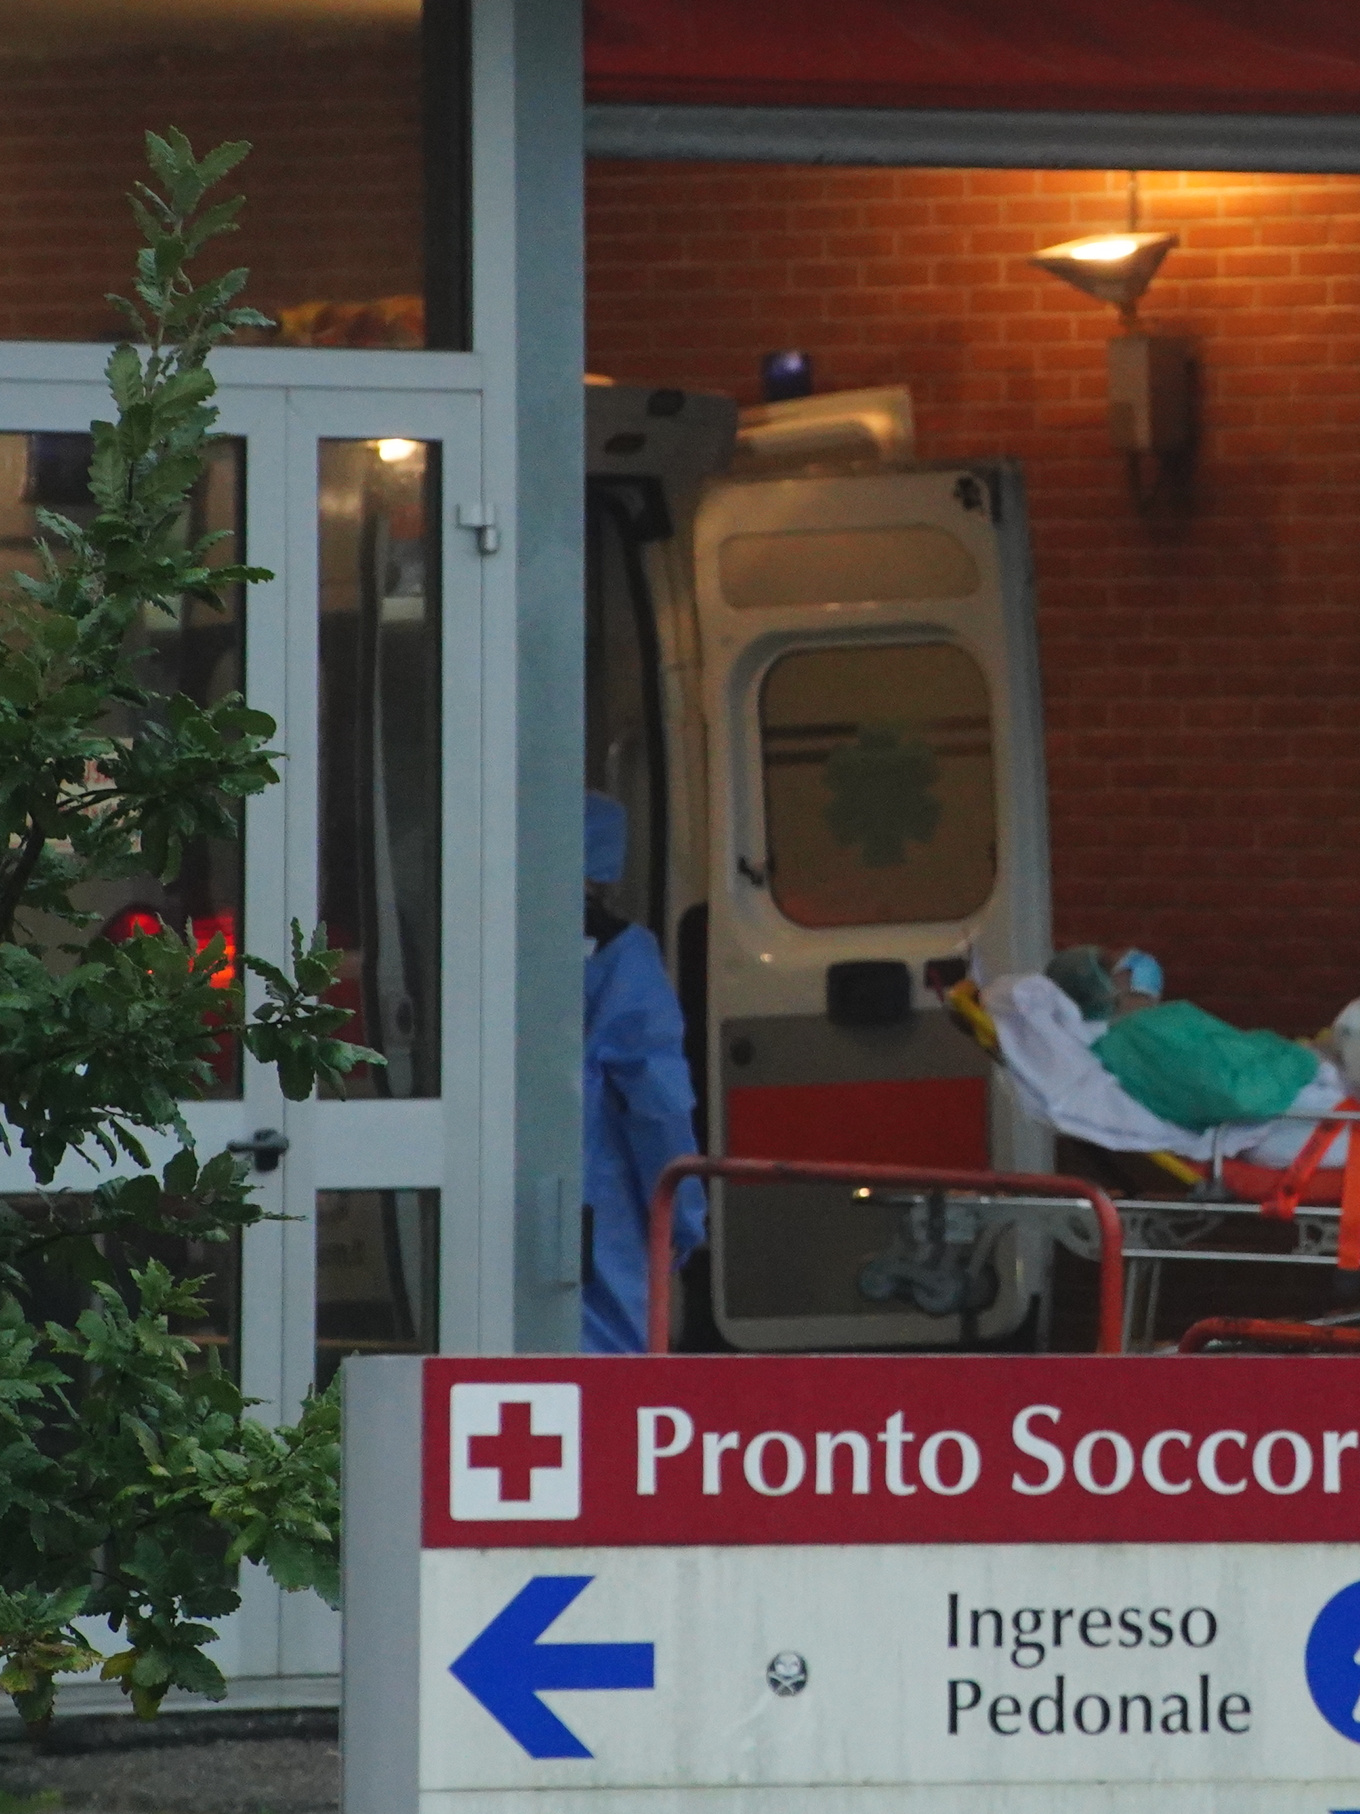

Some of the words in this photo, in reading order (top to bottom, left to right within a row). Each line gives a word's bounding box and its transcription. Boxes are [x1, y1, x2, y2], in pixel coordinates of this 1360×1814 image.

[636, 1406, 981, 1497] Pronto
[948, 1593, 1218, 1669] Ingresso
[948, 1674, 1251, 1735] Pedonale
